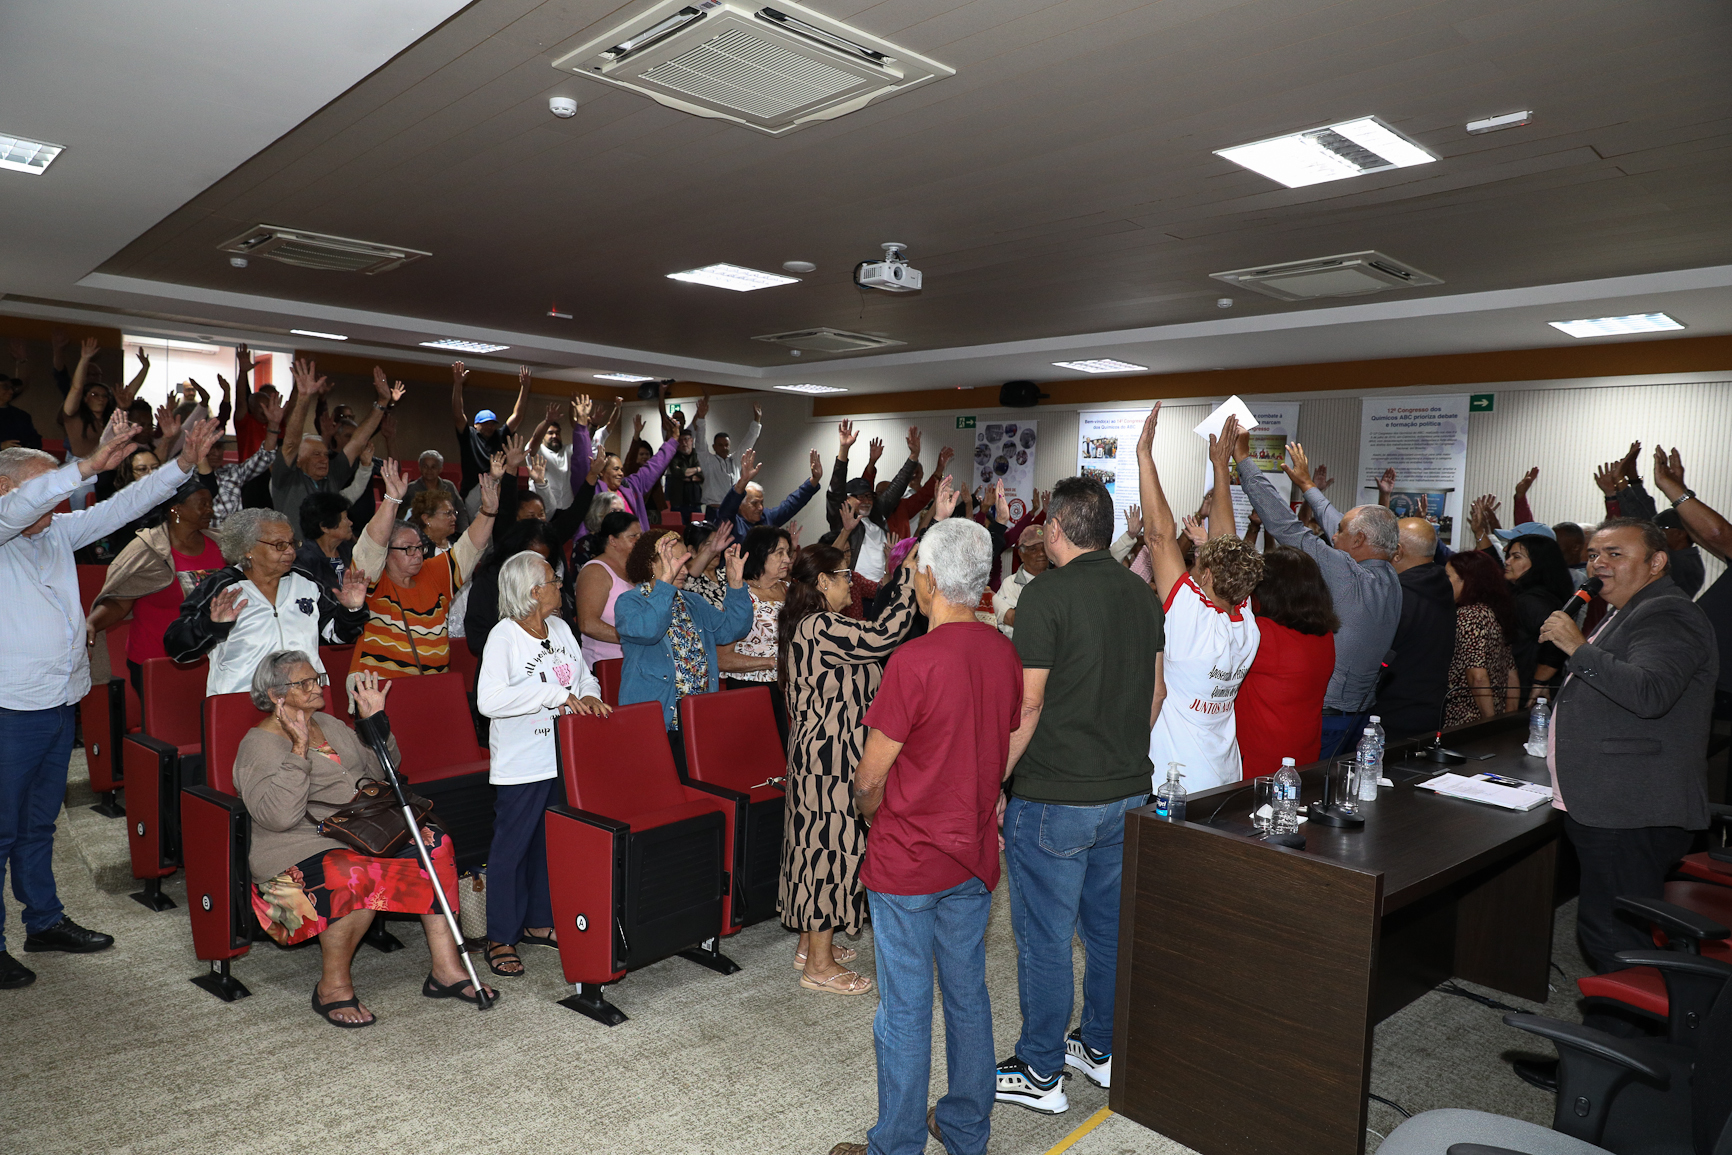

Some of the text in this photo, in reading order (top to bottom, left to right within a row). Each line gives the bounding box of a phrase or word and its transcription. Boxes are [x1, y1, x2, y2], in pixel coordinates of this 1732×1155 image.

[525, 661, 537, 677] all
[1189, 698, 1221, 714] JUNTOS
[534, 727, 551, 737] cup
